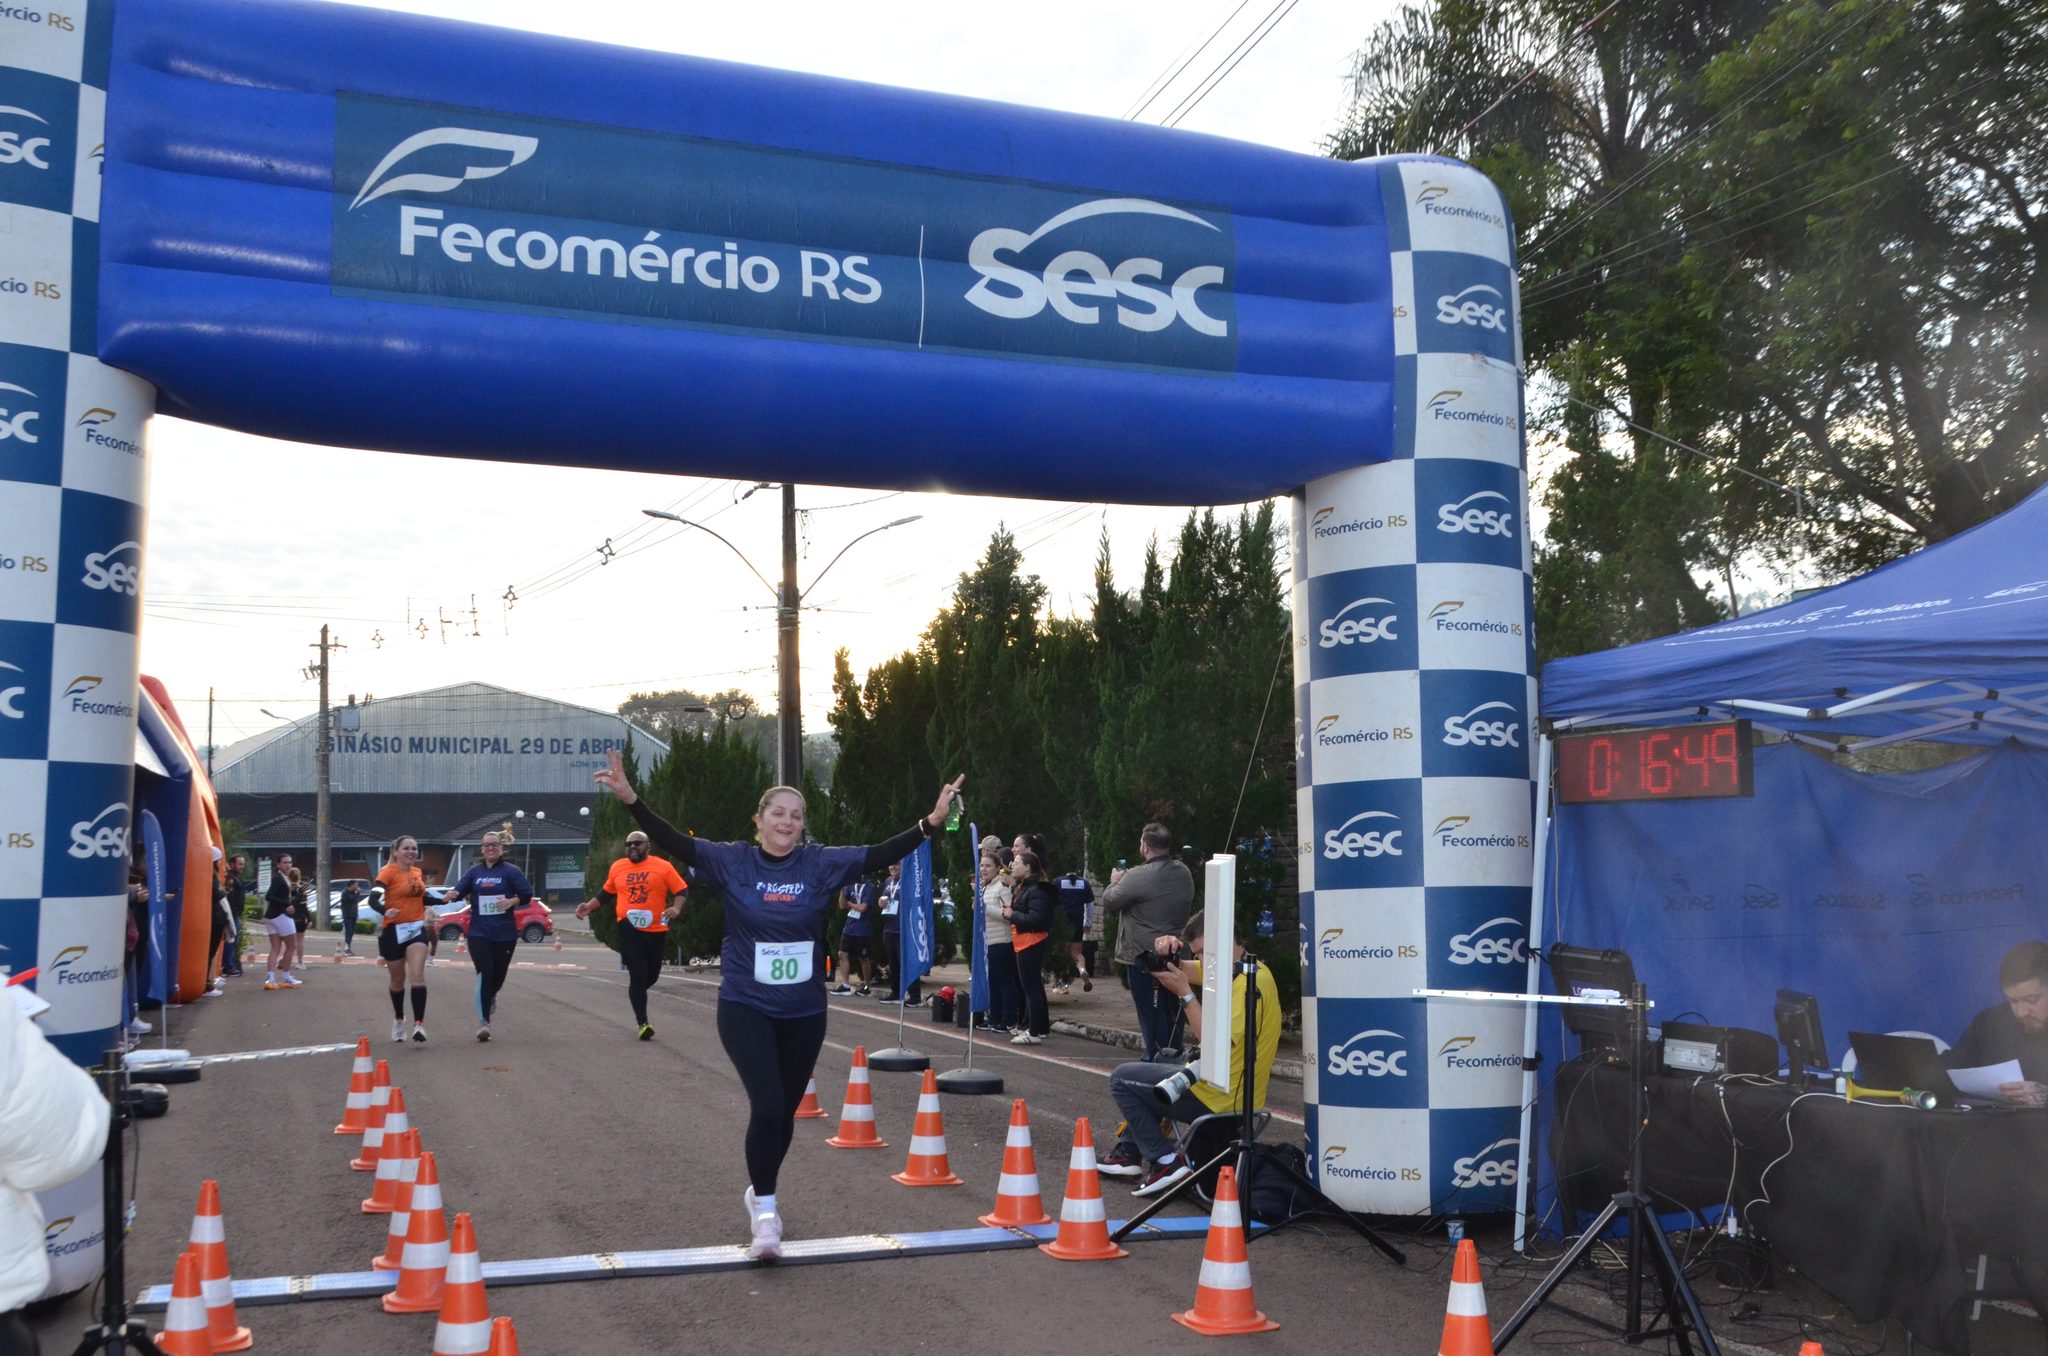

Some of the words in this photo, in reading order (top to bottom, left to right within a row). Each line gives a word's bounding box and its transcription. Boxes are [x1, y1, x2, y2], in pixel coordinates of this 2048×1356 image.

[47, 12, 75, 32] RS
[1425, 203, 1493, 225] Fecomércio
[400, 204, 780, 293] Fecomércio
[800, 249, 883, 304] RS
[963, 198, 1228, 337] Sesc
[34, 281, 61, 300] RS
[1436, 284, 1507, 333] Sesc
[1434, 407, 1504, 426] Fecomércio
[1505, 415, 1517, 430] RS
[1436, 490, 1512, 538] Sesc
[1314, 517, 1383, 539] Fecomércio
[1387, 514, 1408, 528] RS
[21, 556, 48, 573] RS
[81, 541, 142, 597] Ses
[1319, 597, 1398, 648] Sesc
[1436, 618, 1509, 635] Fecomércio
[1510, 623, 1522, 637] RS
[1442, 701, 1519, 748] Sesc
[409, 737, 513, 754] MUNICIPAL
[520, 737, 544, 754] 29
[550, 738, 573, 754] DE
[1319, 728, 1389, 746] Fecomércio
[1393, 727, 1414, 740] RS
[8, 832, 34, 849] RS
[1323, 811, 1403, 860] Sesc
[1441, 834, 1515, 848] Fecomércio
[1517, 835, 1529, 848] RS
[632, 916, 647, 927] 70
[1323, 945, 1393, 959] Fecomércio
[1397, 946, 1418, 958] RS
[1448, 917, 1526, 965] Sesc
[770, 957, 799, 981] 80
[1327, 1029, 1407, 1077] Sesc
[1447, 1053, 1522, 1068] Fecomércio
[1326, 1163, 1397, 1181] Fecomércio
[1401, 1168, 1422, 1181] RS
[1451, 1138, 1530, 1188] Ses
